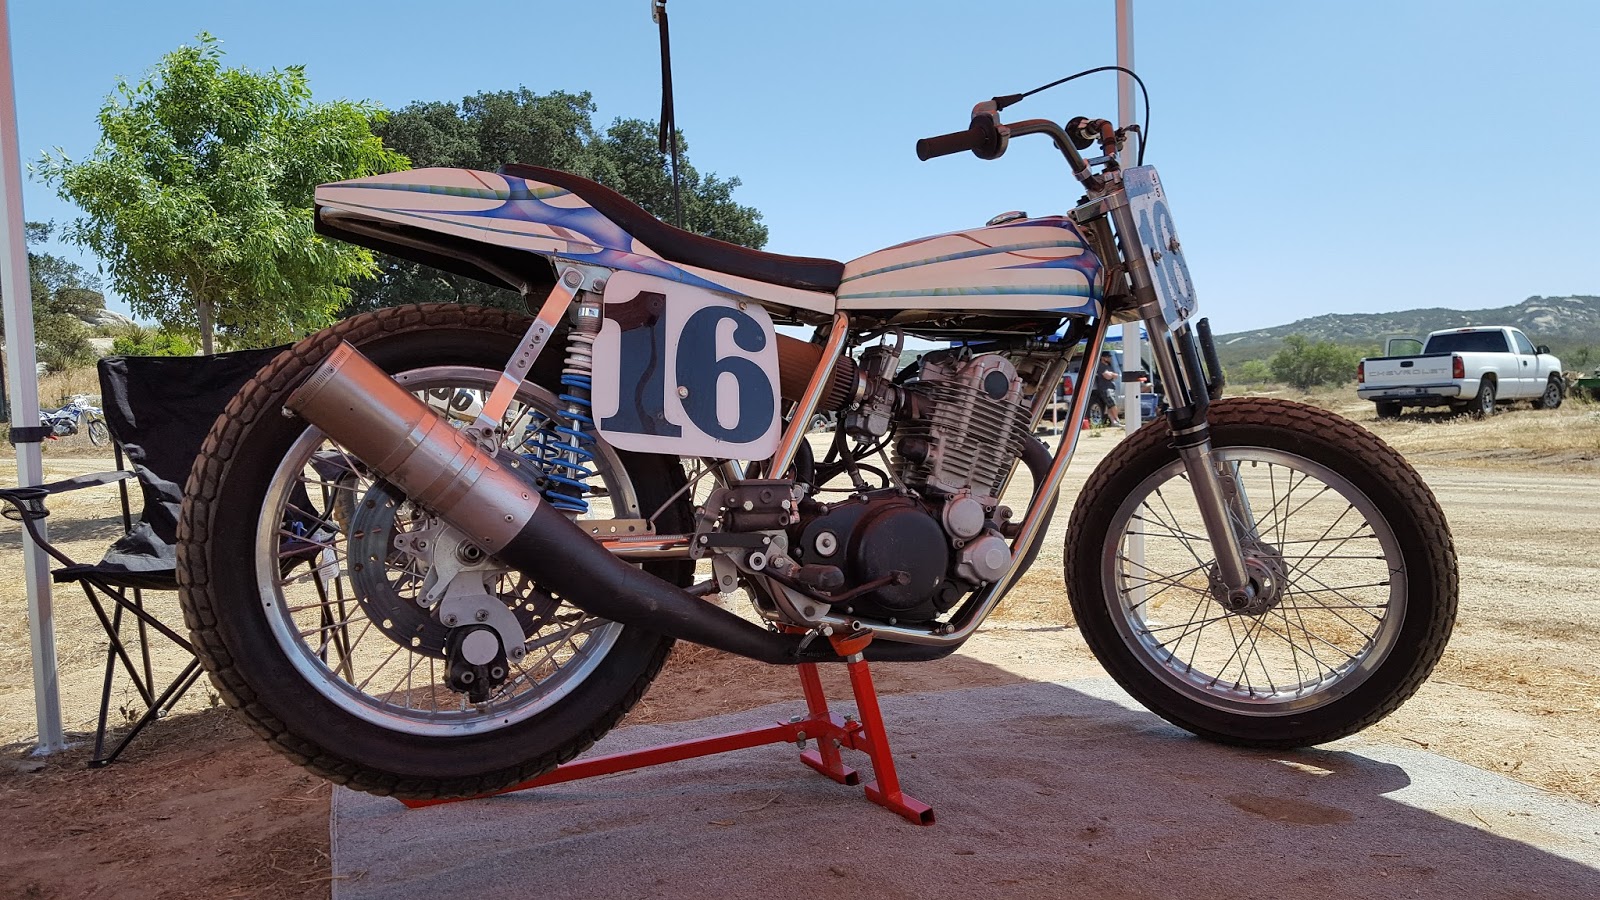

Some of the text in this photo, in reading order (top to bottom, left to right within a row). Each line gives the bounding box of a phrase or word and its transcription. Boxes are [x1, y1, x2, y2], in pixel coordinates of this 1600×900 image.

[1137, 200, 1195, 326] 16
[600, 290, 775, 444] 16
[1368, 367, 1448, 377] CHEVROLET
